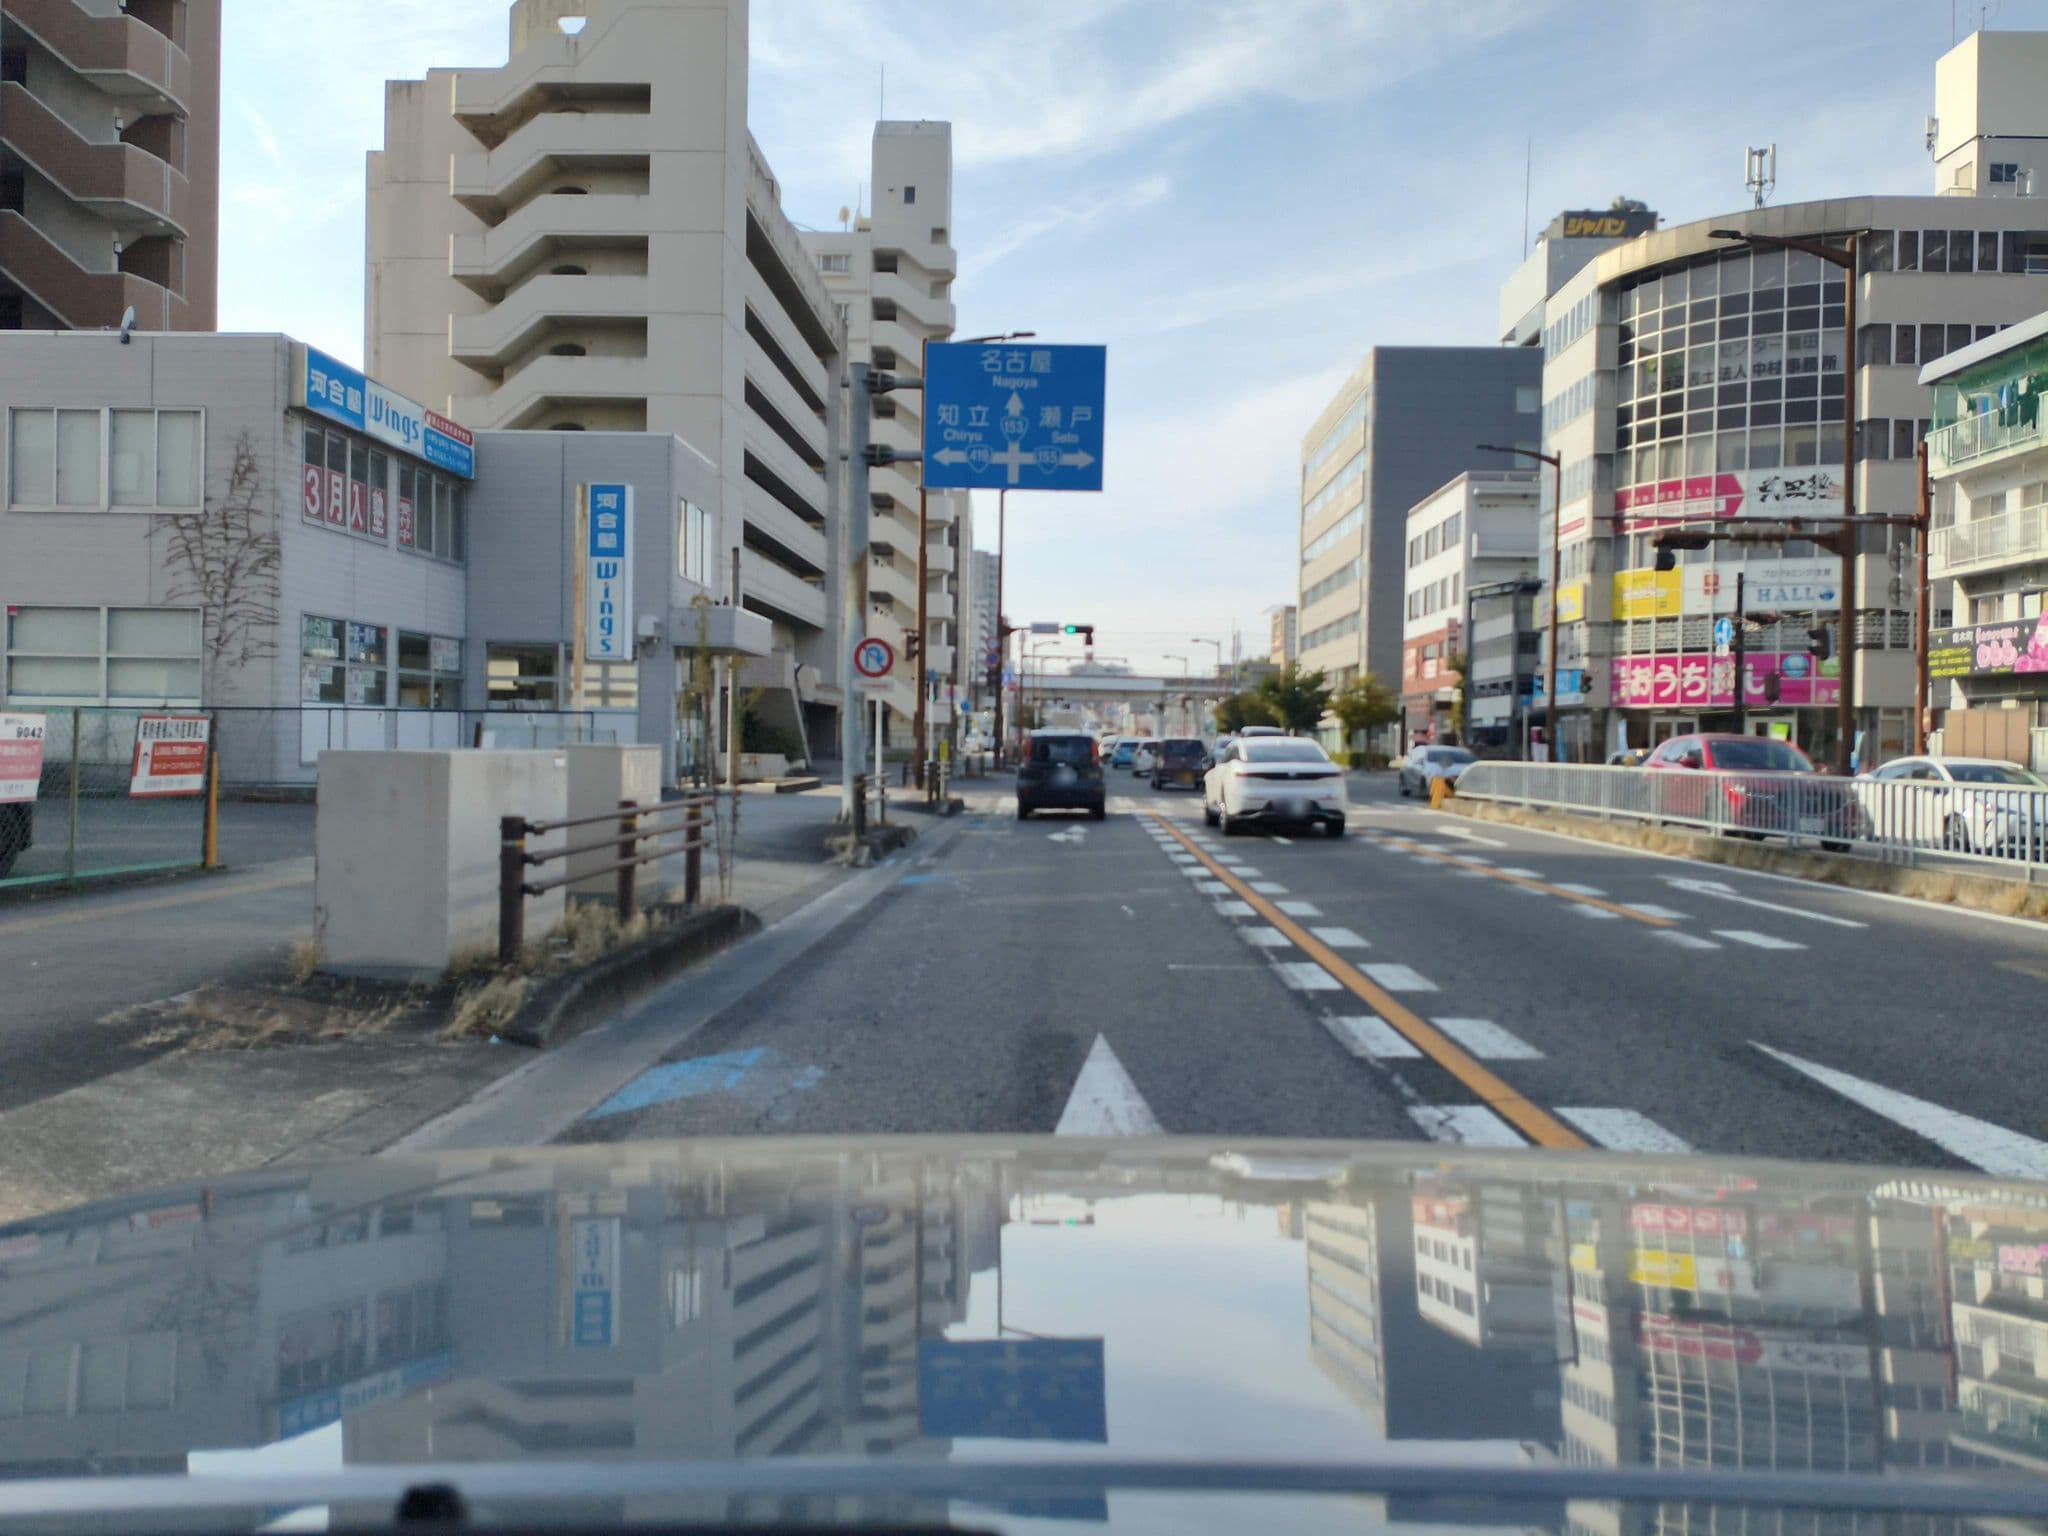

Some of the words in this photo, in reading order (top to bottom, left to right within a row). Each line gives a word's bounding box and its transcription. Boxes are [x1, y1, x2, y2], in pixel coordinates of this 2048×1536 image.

[981, 350, 1051, 373] 名古屋
[310, 368, 362, 414] 河合塾
[993, 375, 1038, 389] Nagoya
[369, 393, 419, 443] Wings
[937, 404, 990, 426] 知立
[1039, 406, 1092, 428] 瀬戸
[943, 428, 983, 442] Chiryu
[1051, 431, 1079, 444] Seto
[597, 493, 618, 548] 河合塾
[596, 562, 618, 652] Wings
